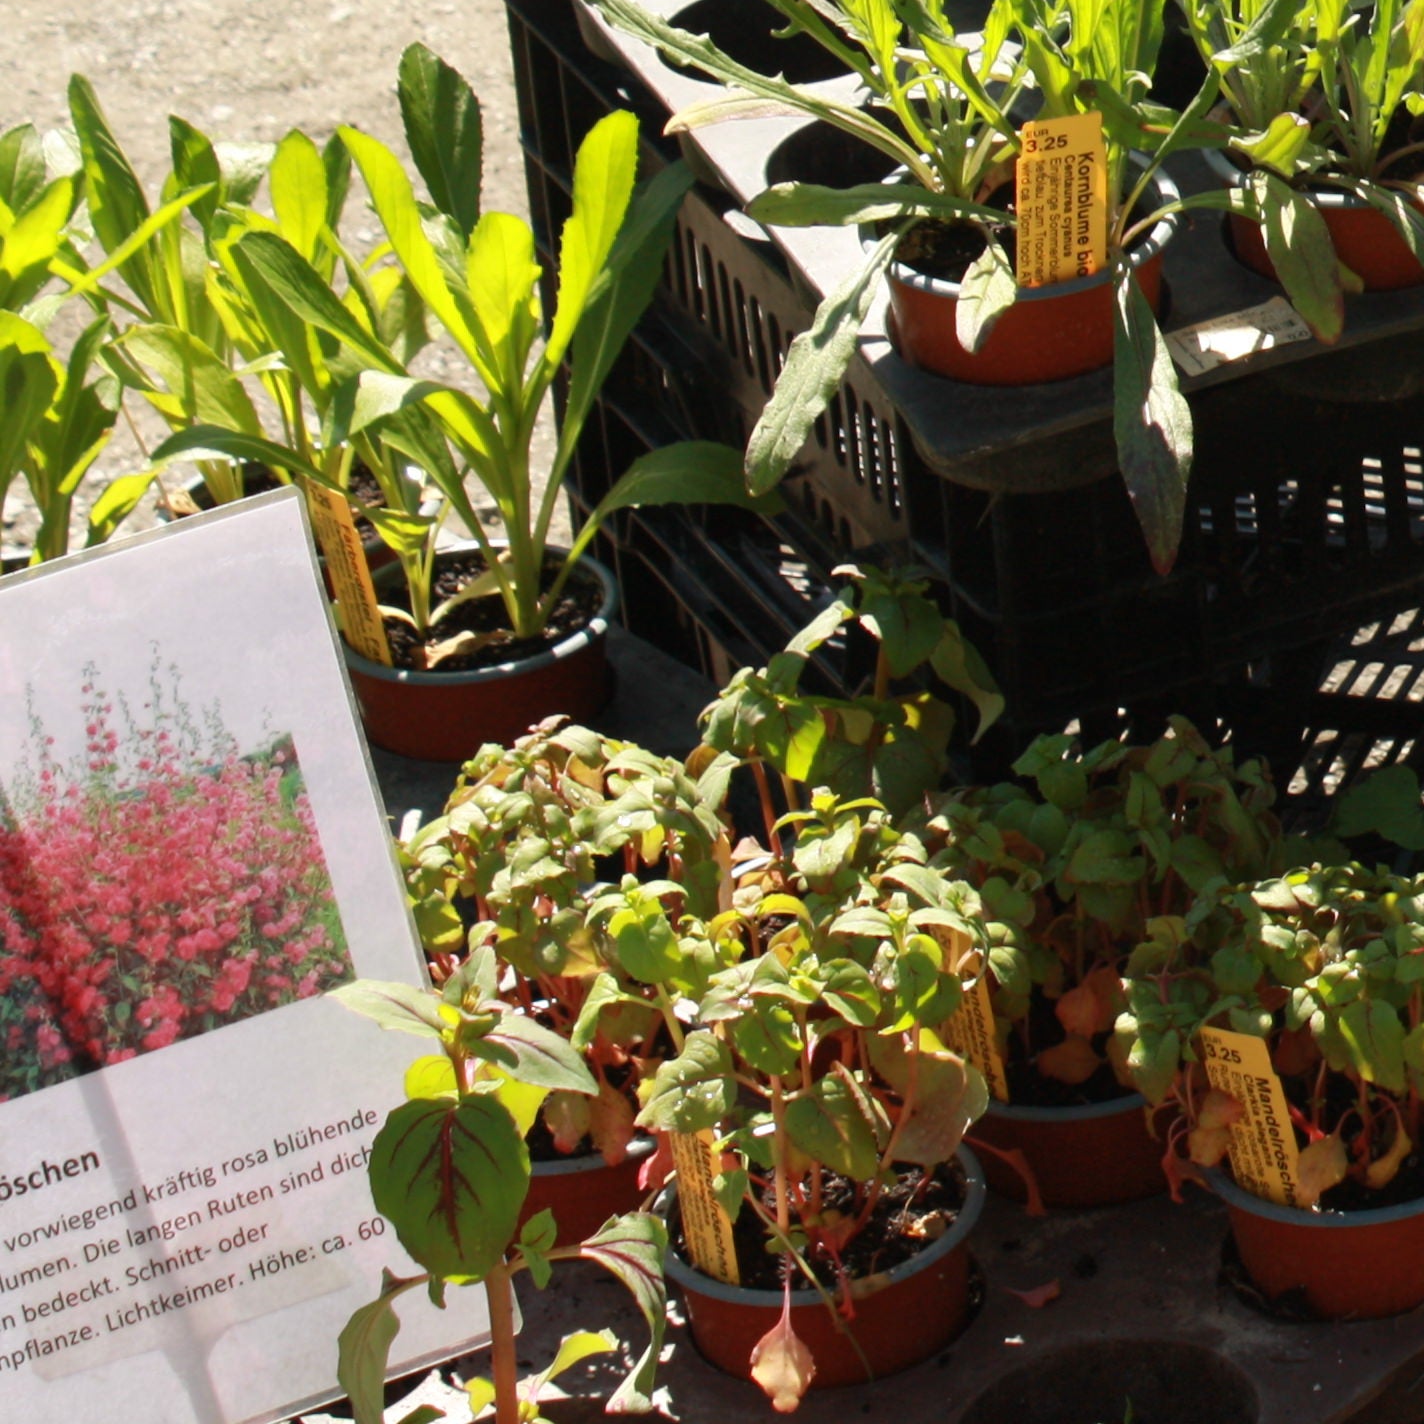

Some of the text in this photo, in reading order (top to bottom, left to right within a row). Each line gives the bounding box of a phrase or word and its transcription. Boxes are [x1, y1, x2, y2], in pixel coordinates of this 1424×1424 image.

[1026, 135, 1068, 153] 3.25
[1063, 155, 1075, 257] Centaurea cyanus
[1077, 152, 1094, 245] Kornblume
[1206, 1043, 1242, 1064] 3.25
[1243, 1073, 1260, 1117] Clarkia
[4, 1108, 379, 1252] vorwiegend kräftig rosa blühende
[84, 1238, 121, 1264] Die
[127, 1210, 202, 1248] langen
[208, 1185, 274, 1219] Ruten
[280, 1161, 324, 1194] sind
[22, 1277, 120, 1324] bedeckt.
[126, 1245, 212, 1287] Schnitt-
[219, 1221, 269, 1254] oder
[106, 1272, 244, 1333] Lichtkeimer.
[249, 1244, 316, 1281] Höhe:
[322, 1237, 352, 1255] ca.
[358, 1216, 385, 1241] 60
